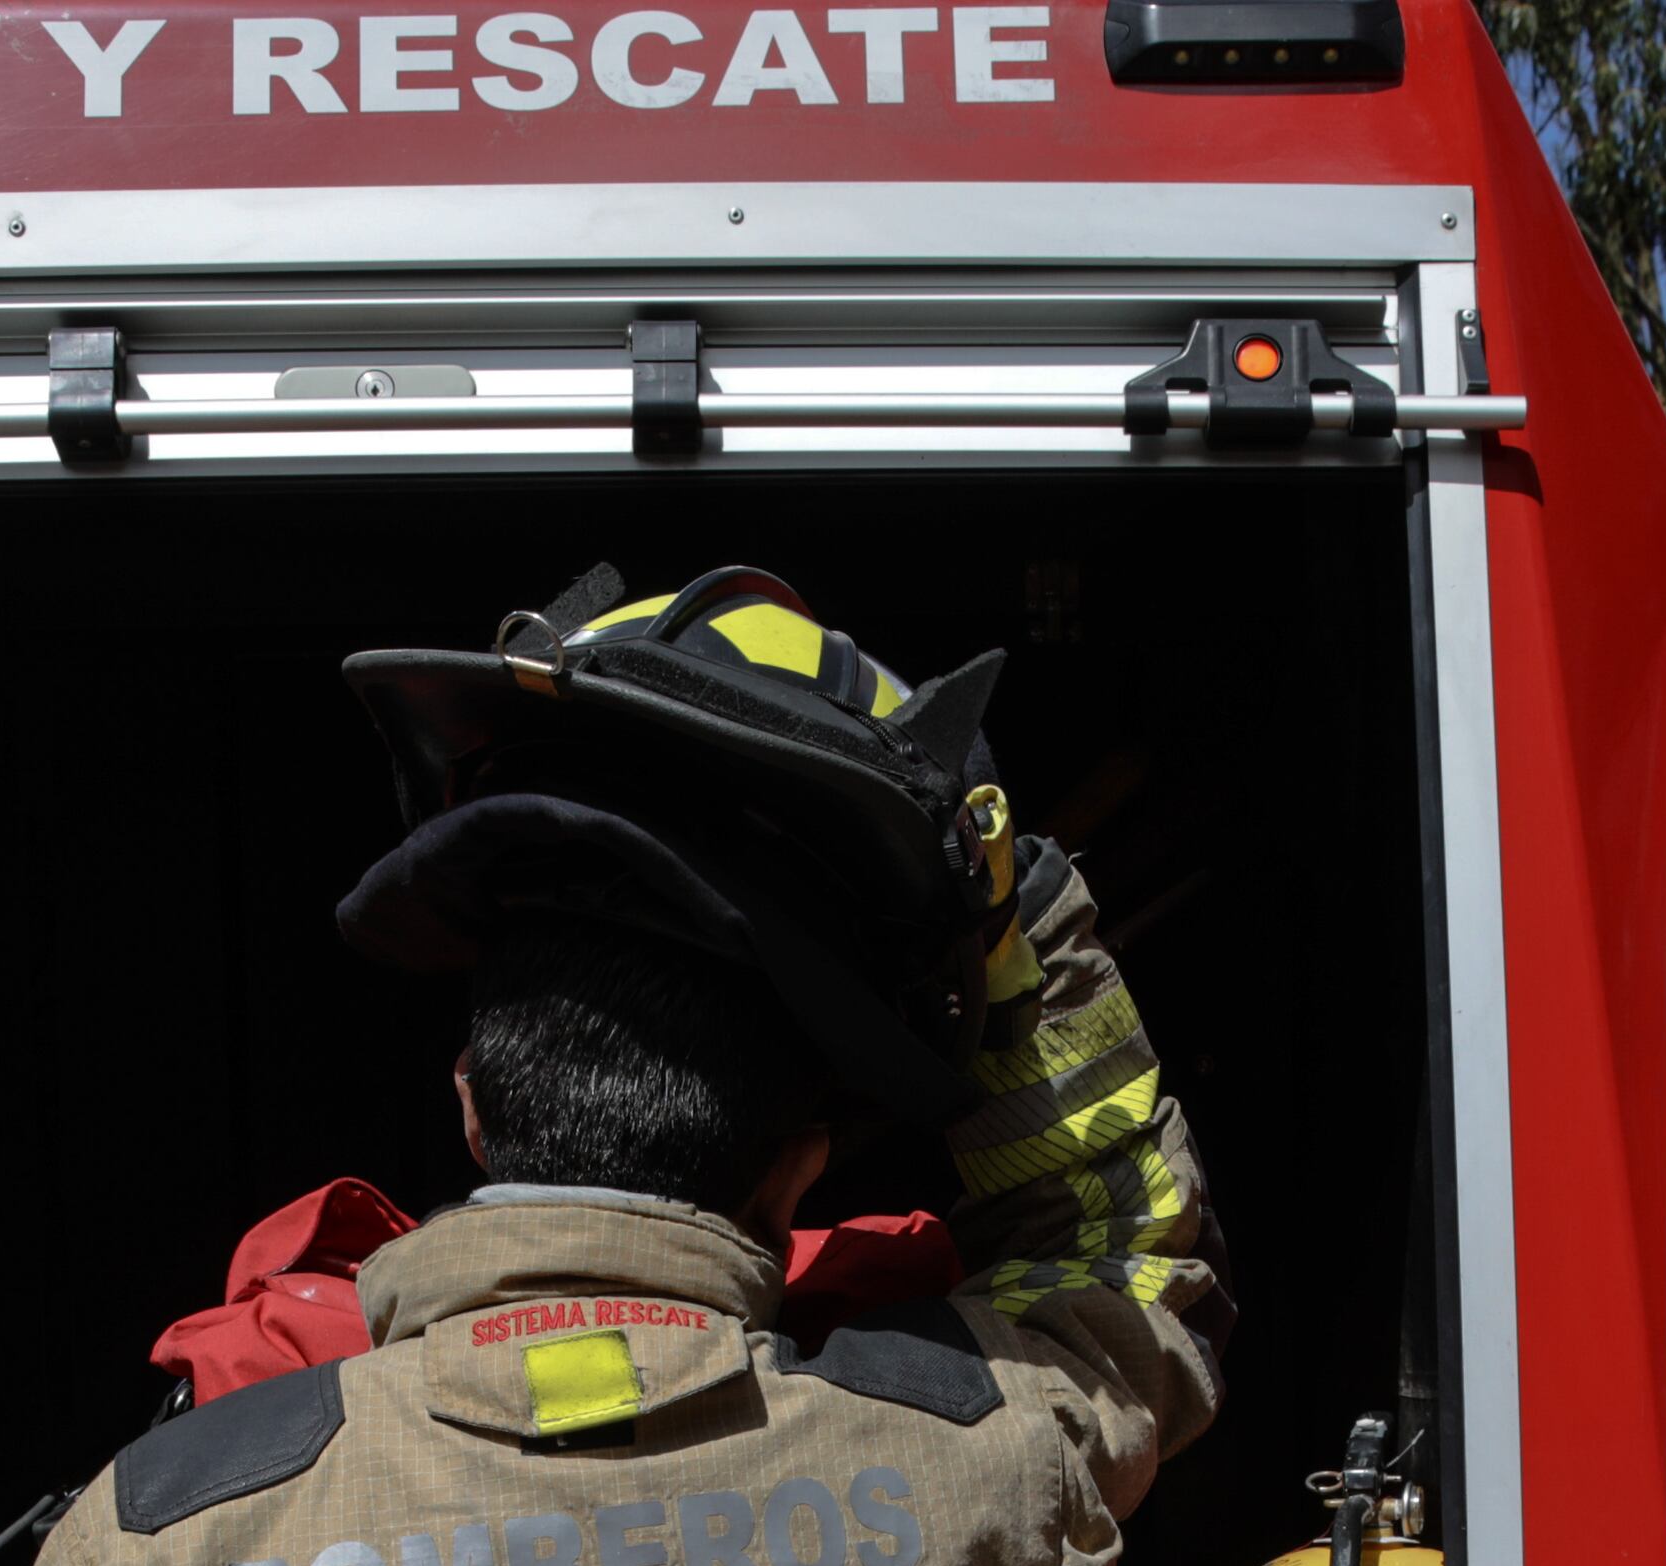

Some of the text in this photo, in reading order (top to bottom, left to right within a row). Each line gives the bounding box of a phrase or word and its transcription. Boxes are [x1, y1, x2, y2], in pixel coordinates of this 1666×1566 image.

[41, 19, 168, 118] Y
[232, 5, 1056, 116] RESCATE
[472, 1299, 709, 1347] SISTEMA RESCATE
